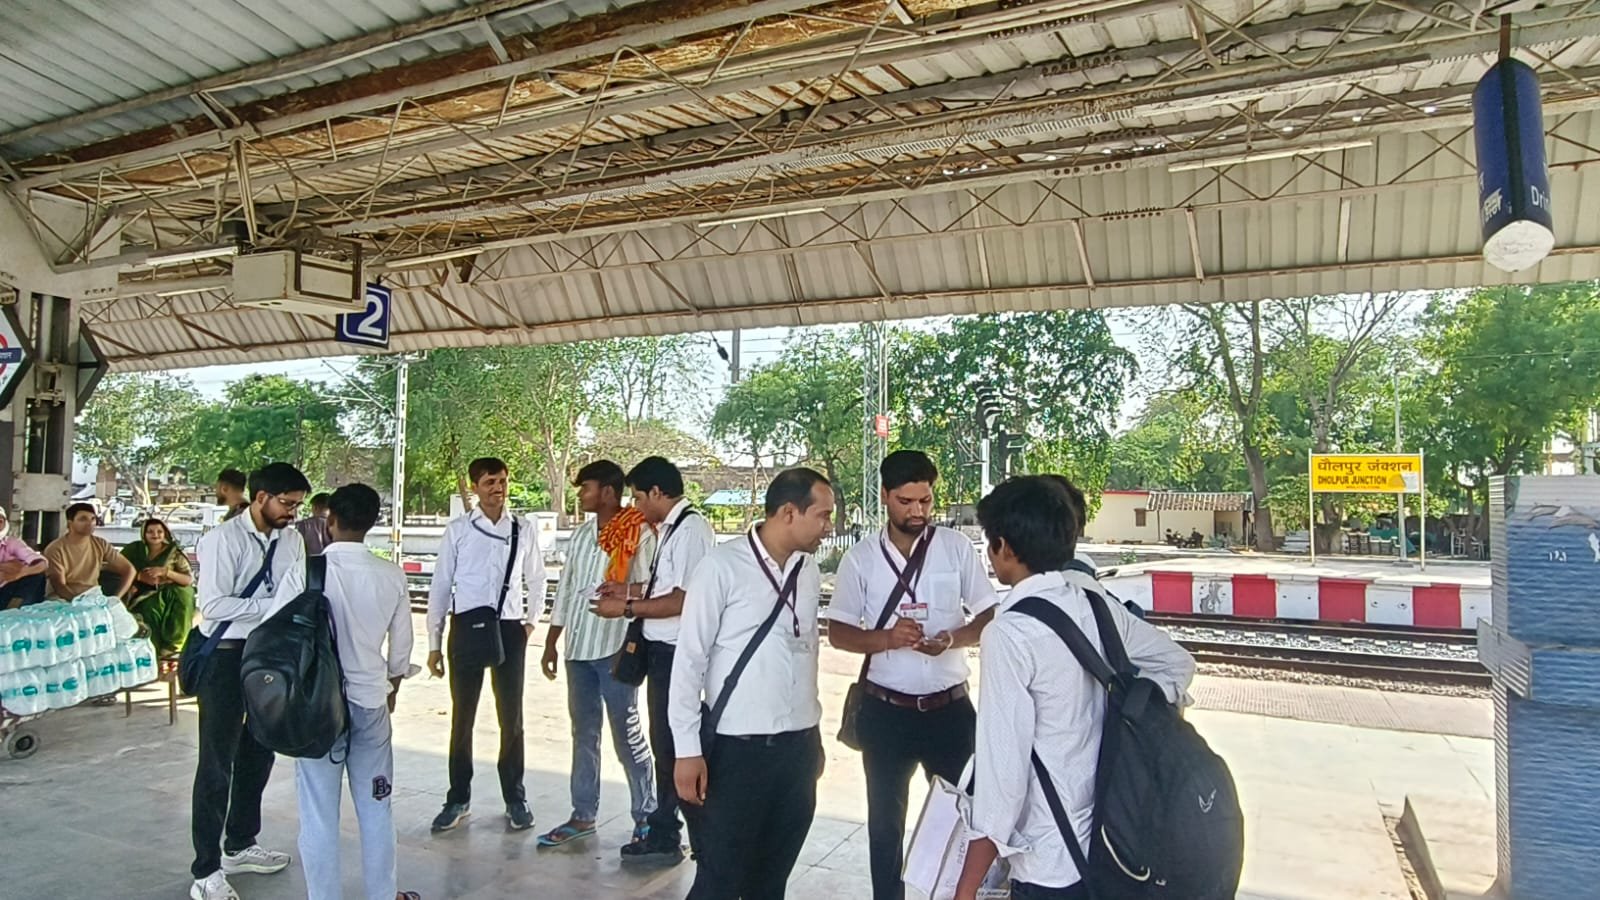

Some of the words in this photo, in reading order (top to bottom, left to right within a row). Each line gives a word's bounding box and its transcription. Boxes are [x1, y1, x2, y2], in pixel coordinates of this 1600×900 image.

[358, 294, 383, 336] 2
[1318, 475, 1349, 485] DHOLPUR
[1351, 475, 1387, 485] JUNCTION
[626, 705, 651, 764] JORDAN
